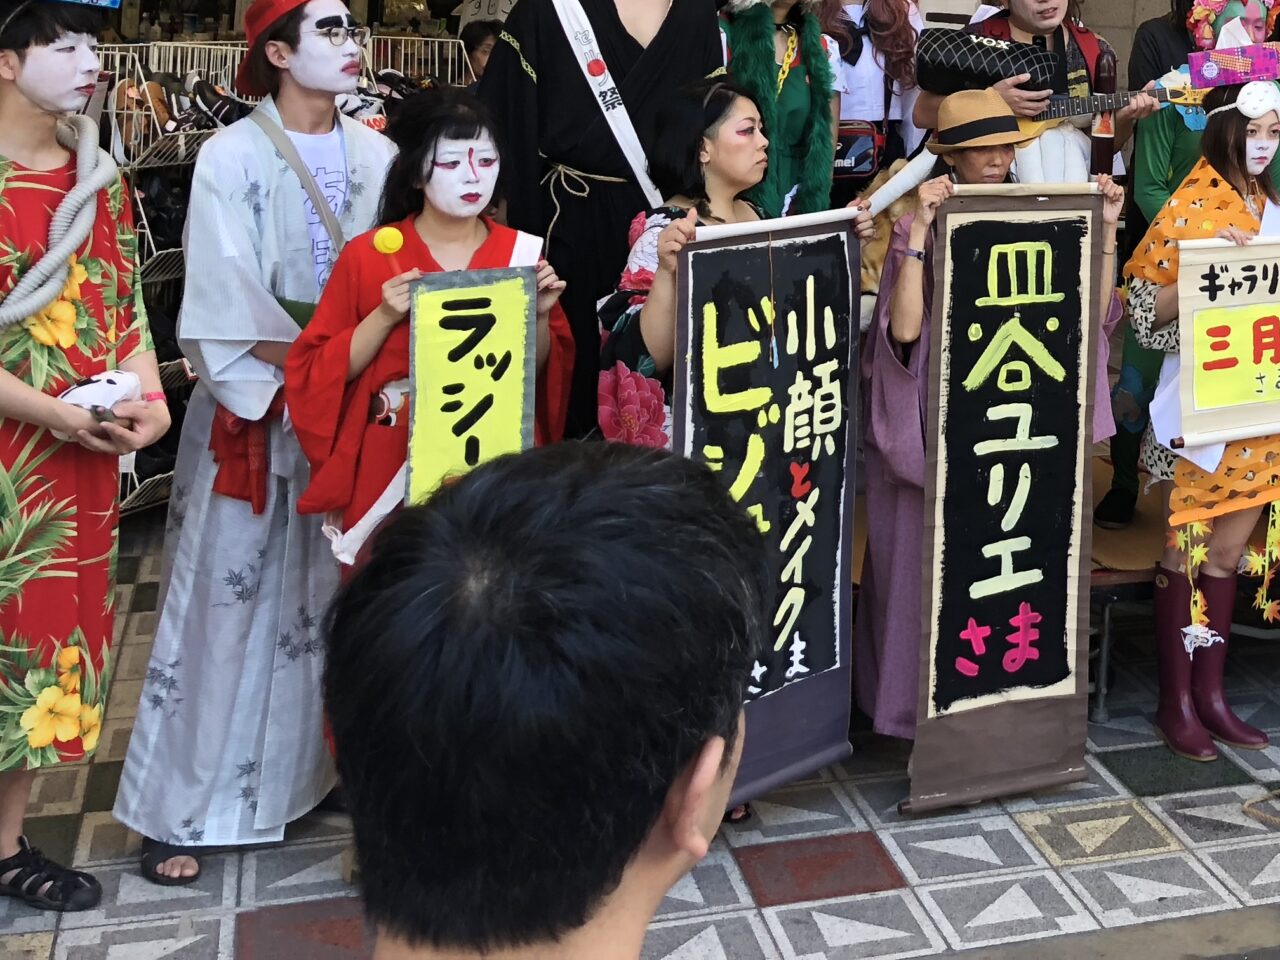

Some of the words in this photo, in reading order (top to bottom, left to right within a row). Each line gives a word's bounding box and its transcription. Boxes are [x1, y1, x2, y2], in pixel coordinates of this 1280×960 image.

[969, 34, 1011, 50] VOX
[438, 297, 513, 467] ラッシー
[962, 240, 1067, 600] 皿谷ユリエ
[954, 600, 1043, 678] さま
